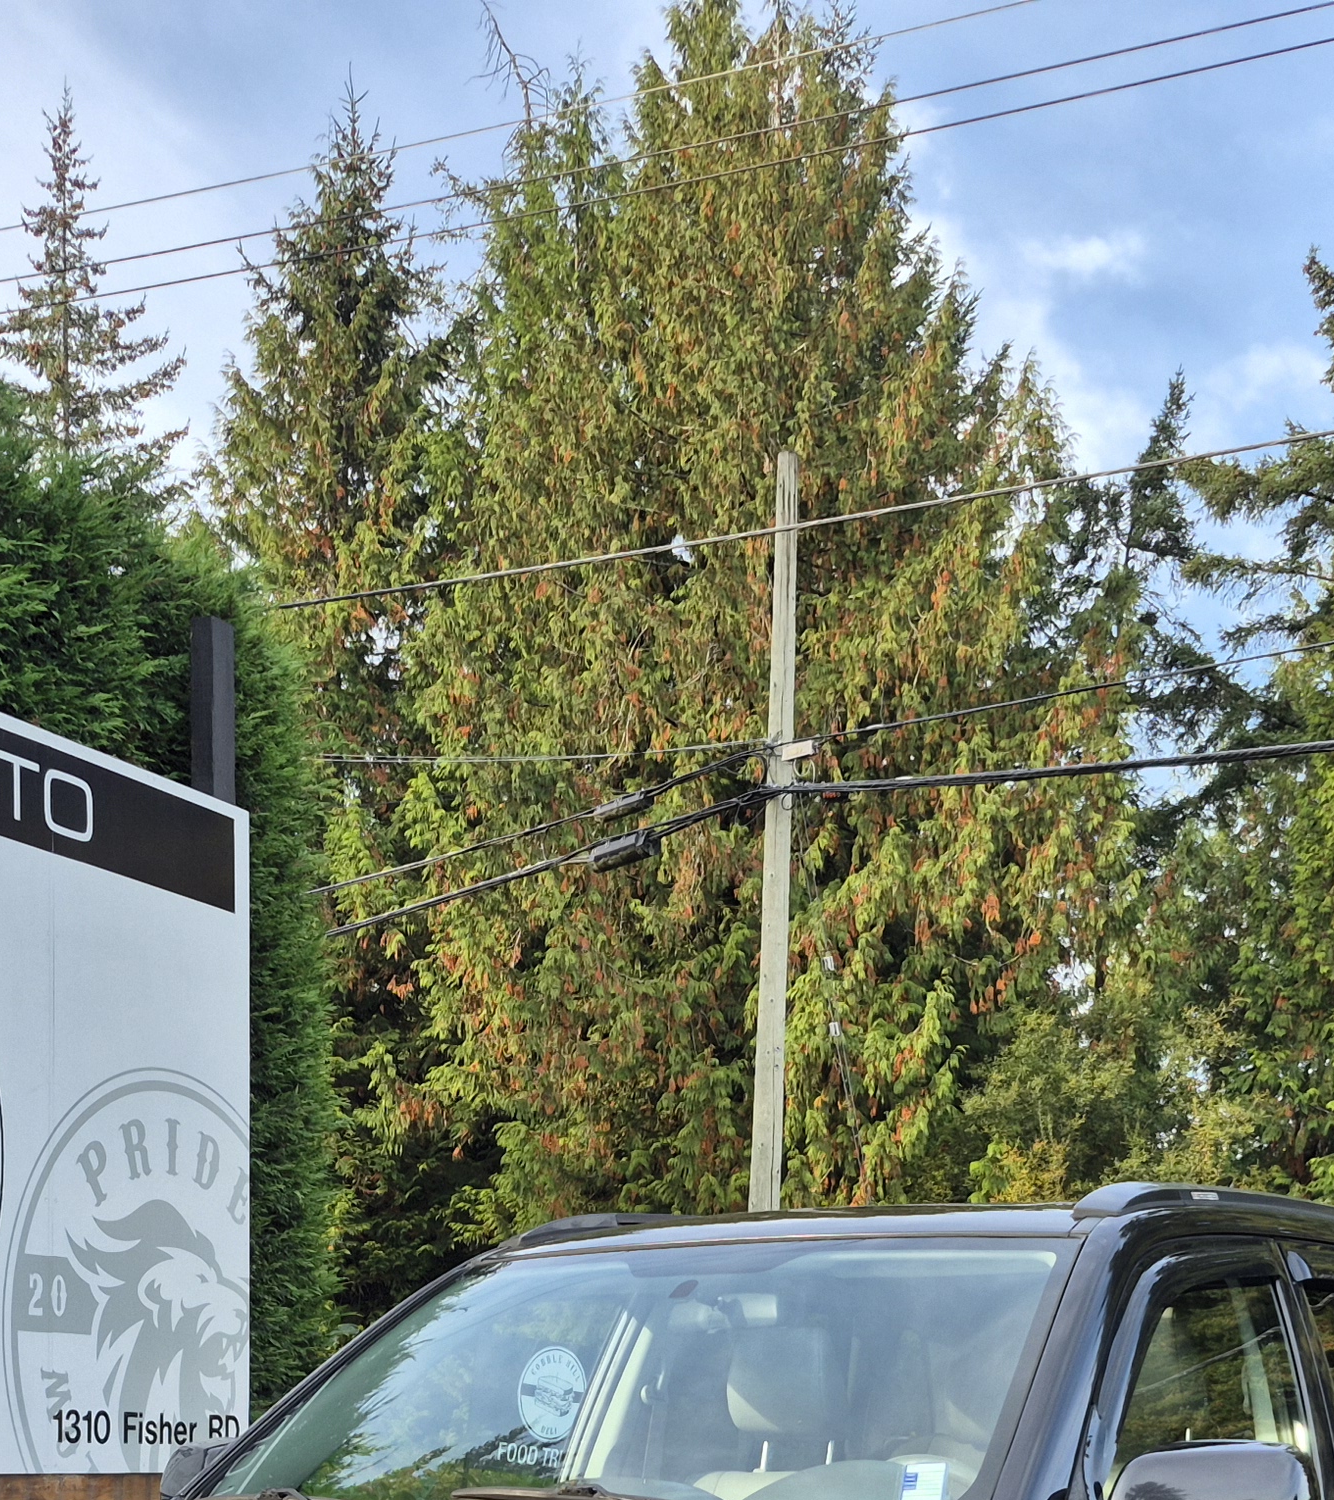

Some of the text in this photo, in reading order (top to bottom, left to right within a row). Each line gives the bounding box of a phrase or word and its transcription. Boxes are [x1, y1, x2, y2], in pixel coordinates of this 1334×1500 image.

[28, 1272, 68, 1318] 20
[52, 1408, 241, 1446] 1310 Fisher RD
[497, 1441, 539, 1466] FOOD
